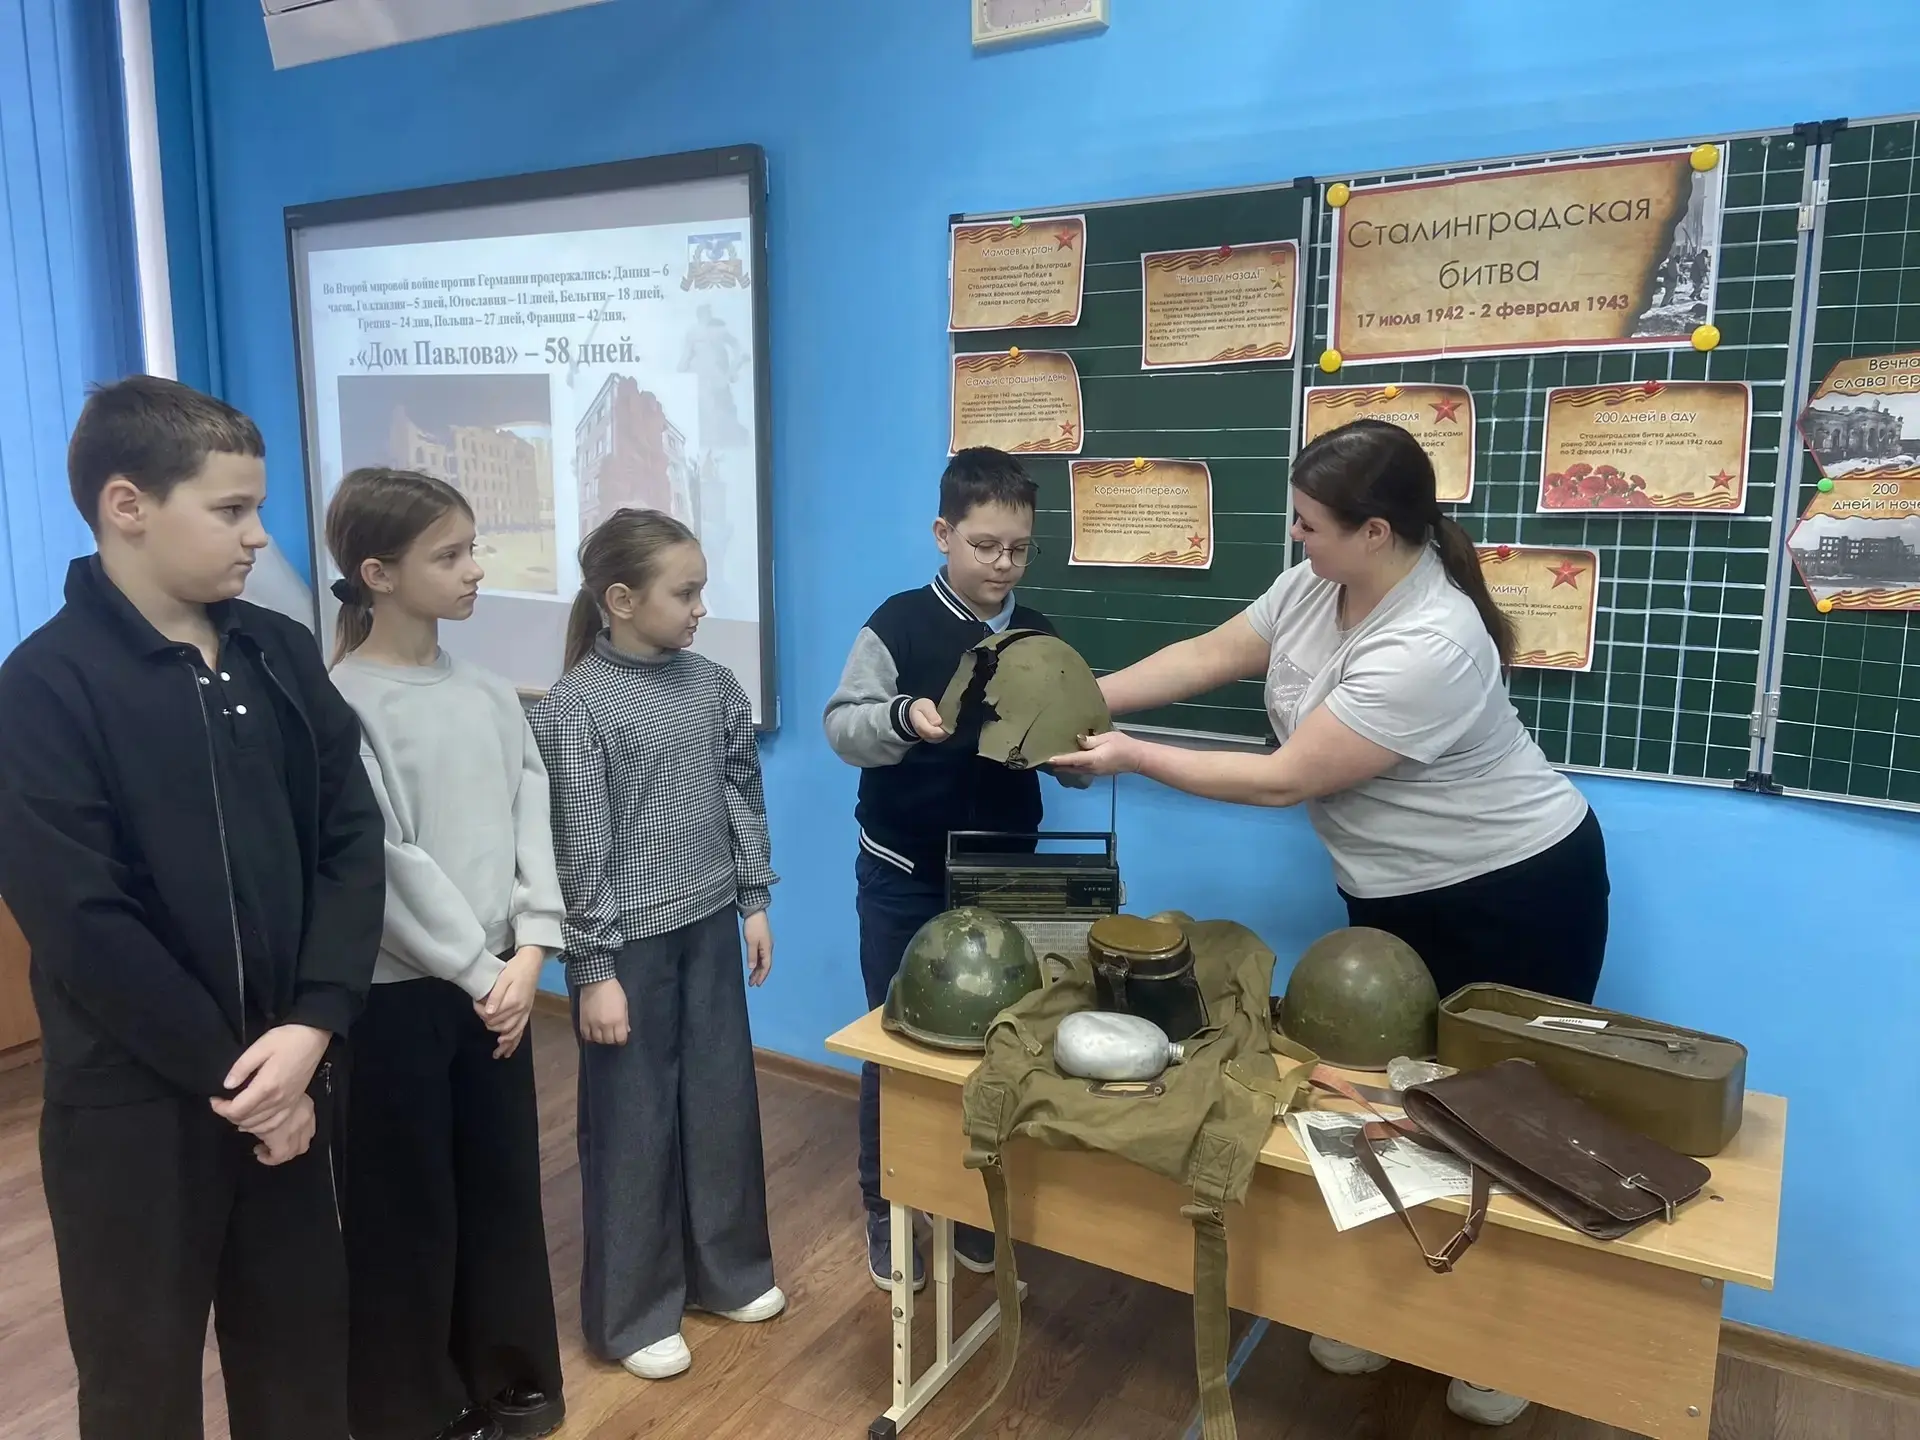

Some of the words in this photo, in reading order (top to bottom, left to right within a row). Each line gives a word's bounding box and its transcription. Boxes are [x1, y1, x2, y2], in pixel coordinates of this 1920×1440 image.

[1348, 198, 1651, 248] Сталинградская
[981, 247, 1020, 257] Мамаев
[1022, 245, 1054, 256] курган
[323, 282, 335, 296] Во
[336, 280, 368, 296] Второй
[370, 278, 409, 295] мировой
[411, 277, 439, 290] войне
[441, 276, 476, 292] против
[478, 273, 529, 289] Германии
[530, 270, 612, 288] продержались:
[613, 265, 651, 282] Дания
[662, 263, 670, 277] 6
[1023, 272, 1048, 280] Победе
[1439, 259, 1540, 289] битва
[560, 288, 607, 304] Бельгия
[618, 287, 631, 301] 18
[632, 285, 664, 301] дней,
[400, 316, 411, 328] 24
[434, 314, 474, 328] Польша
[484, 312, 495, 326] 27
[498, 312, 525, 326] дней,
[526, 310, 576, 327] Франция
[586, 308, 599, 322] 42
[1357, 313, 1375, 329] 17
[1379, 311, 1421, 328] июля
[1426, 305, 1464, 323] 1942
[1480, 303, 1491, 318] 2
[1495, 300, 1579, 320] февраля
[1586, 294, 1630, 311] 1943
[355, 340, 409, 371] «Дом
[413, 339, 518, 366] Павлова»
[544, 336, 571, 365] 58
[575, 335, 641, 366] дней.
[1048, 372, 1067, 382] день
[1834, 375, 1886, 390] слава
[1367, 411, 1420, 423] февраля
[1595, 411, 1618, 423] 200
[1621, 410, 1656, 423] дней
[1660, 412, 1666, 422] в
[1671, 411, 1697, 424] аду
[1423, 430, 1463, 438] войсками
[1584, 440, 1597, 448] 200
[1686, 438, 1703, 446] 1942
[1094, 485, 1143, 496] Коренной
[1145, 486, 1190, 496] перелом
[1872, 483, 1899, 495] 200
[1832, 498, 1871, 511] дней
[1875, 501, 1885, 510] и
[1491, 585, 1530, 596] минут
